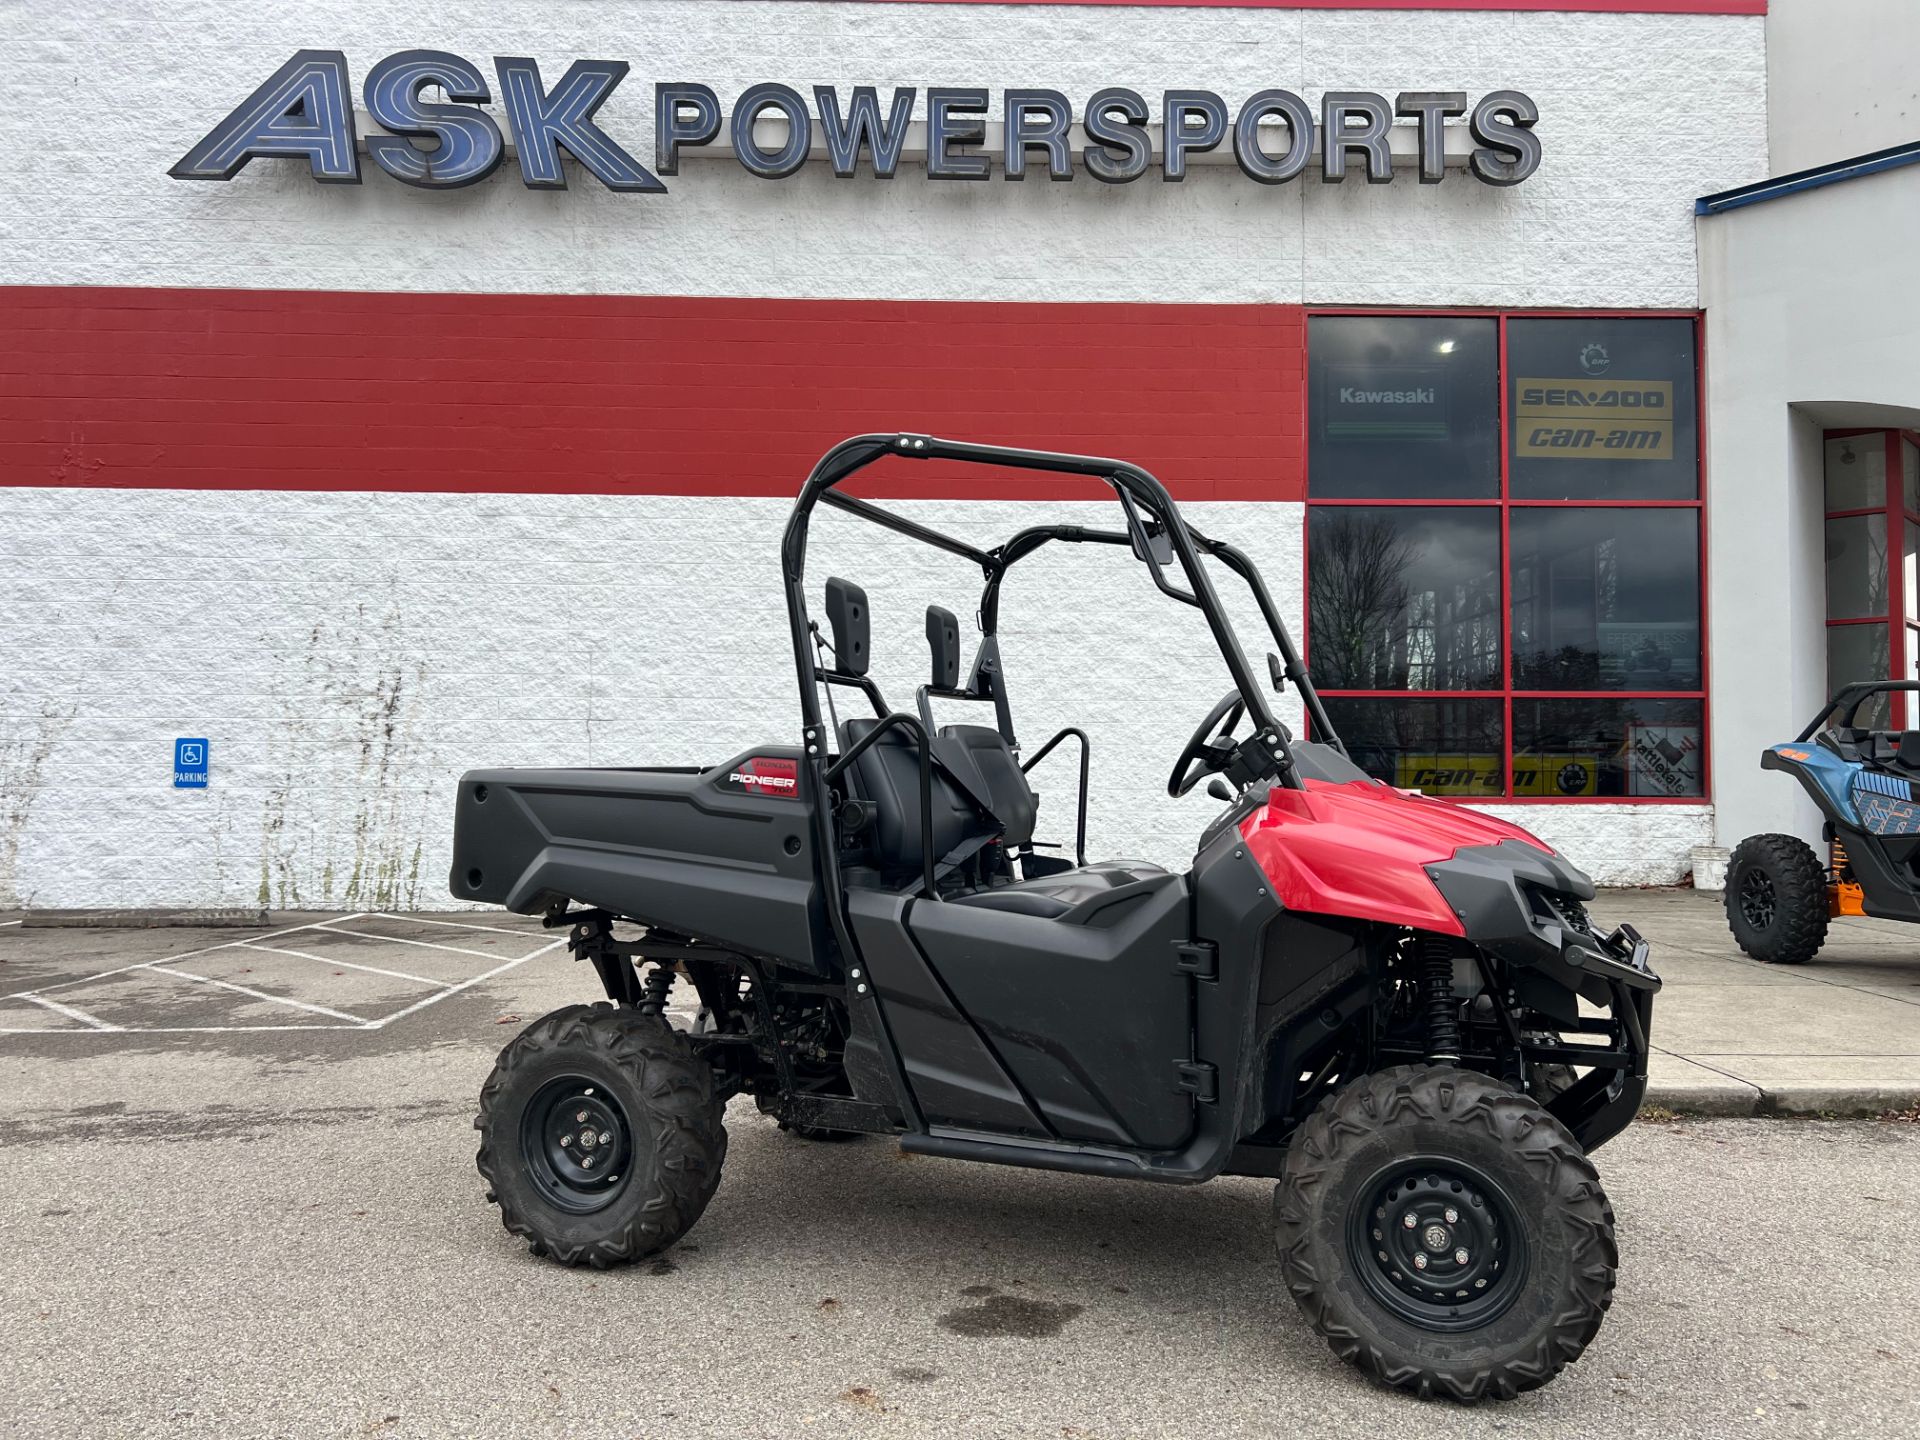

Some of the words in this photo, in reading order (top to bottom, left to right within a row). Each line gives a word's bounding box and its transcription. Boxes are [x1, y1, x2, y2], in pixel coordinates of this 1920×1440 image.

[166, 49, 667, 193] ASK
[655, 82, 1542, 186] POWERSPORTS
[1340, 387, 1435, 404] Kawasaki
[1528, 428, 1663, 450] can-am
[757, 761, 792, 769] HONDA
[174, 772, 207, 783] PARKING
[730, 773, 795, 788] PIONEER
